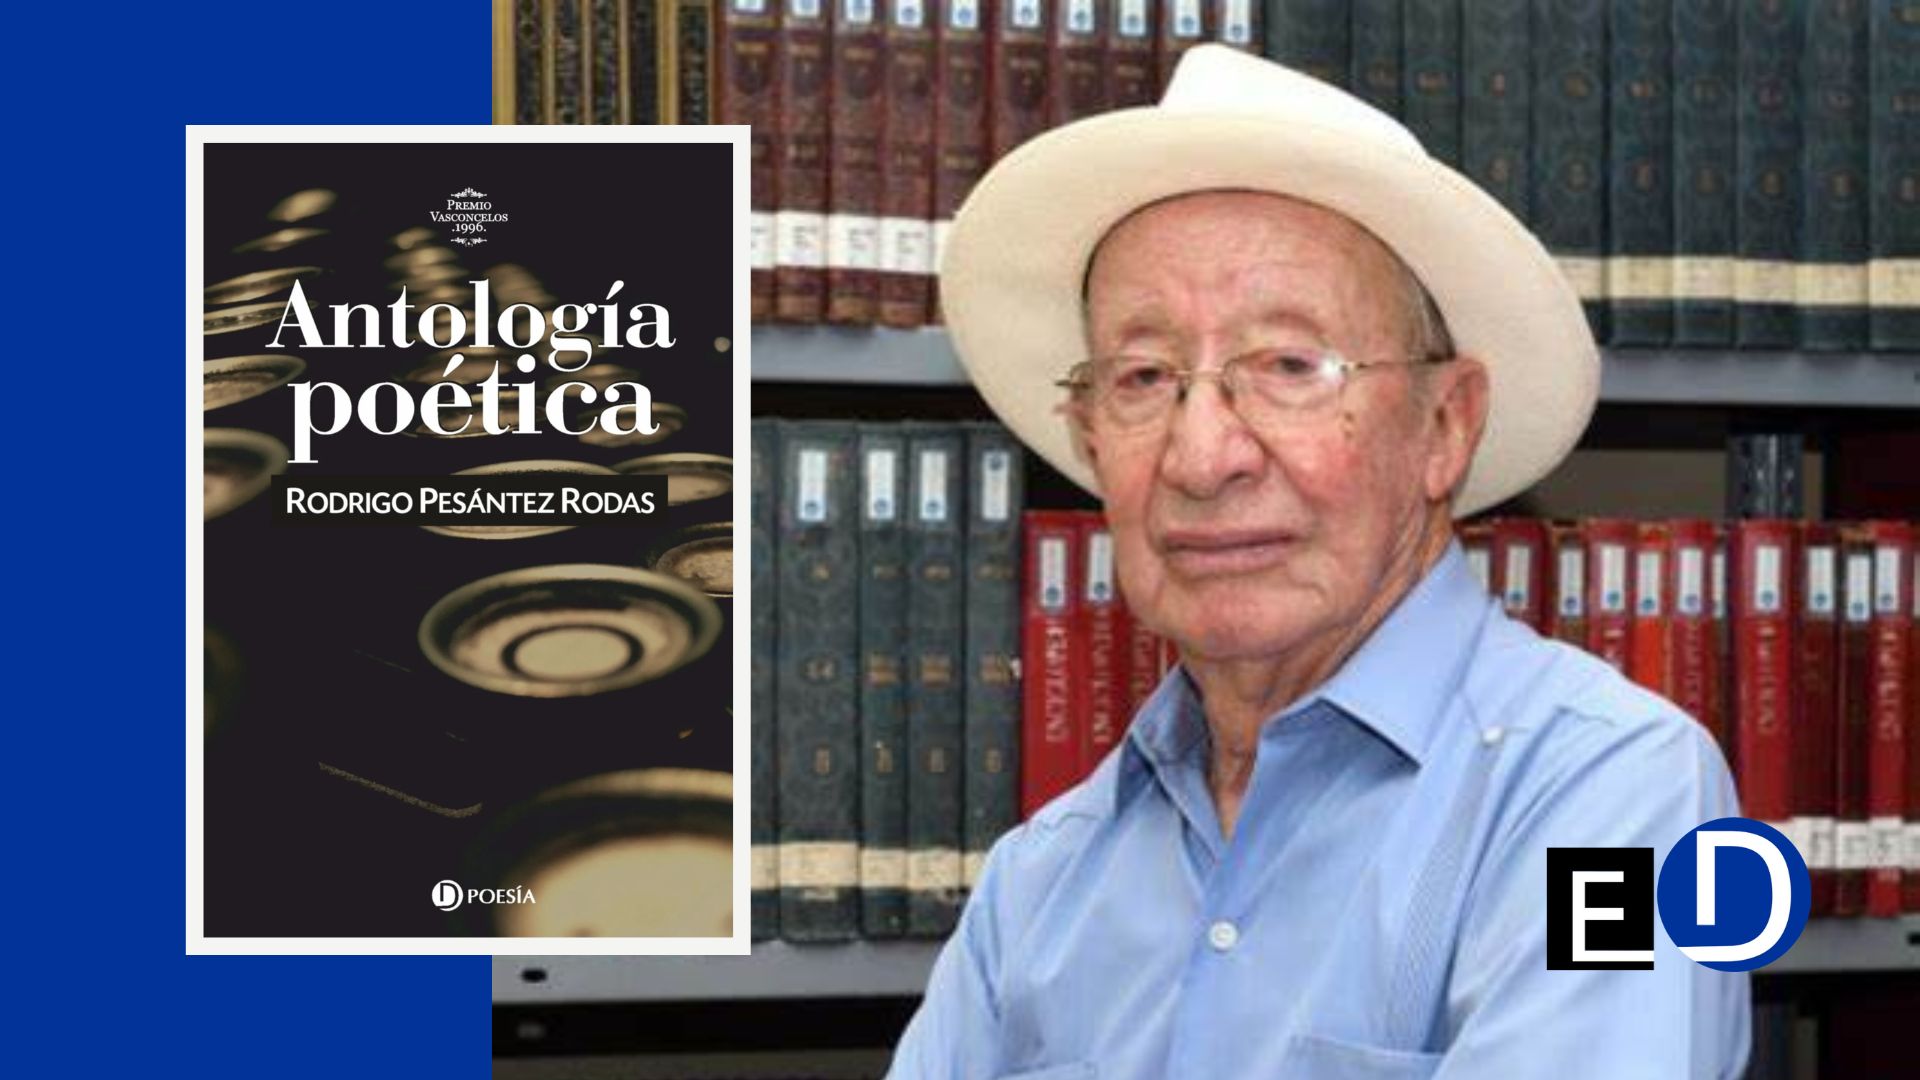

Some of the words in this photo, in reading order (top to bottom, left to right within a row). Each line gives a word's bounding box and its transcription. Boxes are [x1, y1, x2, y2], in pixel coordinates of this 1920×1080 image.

[429, 210, 509, 222] VASCONCELOS
[446, 197, 492, 211] PREMIO
[265, 279, 677, 373] Antología
[286, 353, 661, 464] poética
[285, 486, 414, 515] RODRIGO
[419, 483, 556, 515] PESÁNTEZ
[560, 486, 656, 515] RODAS
[466, 884, 537, 906] POESÍA
